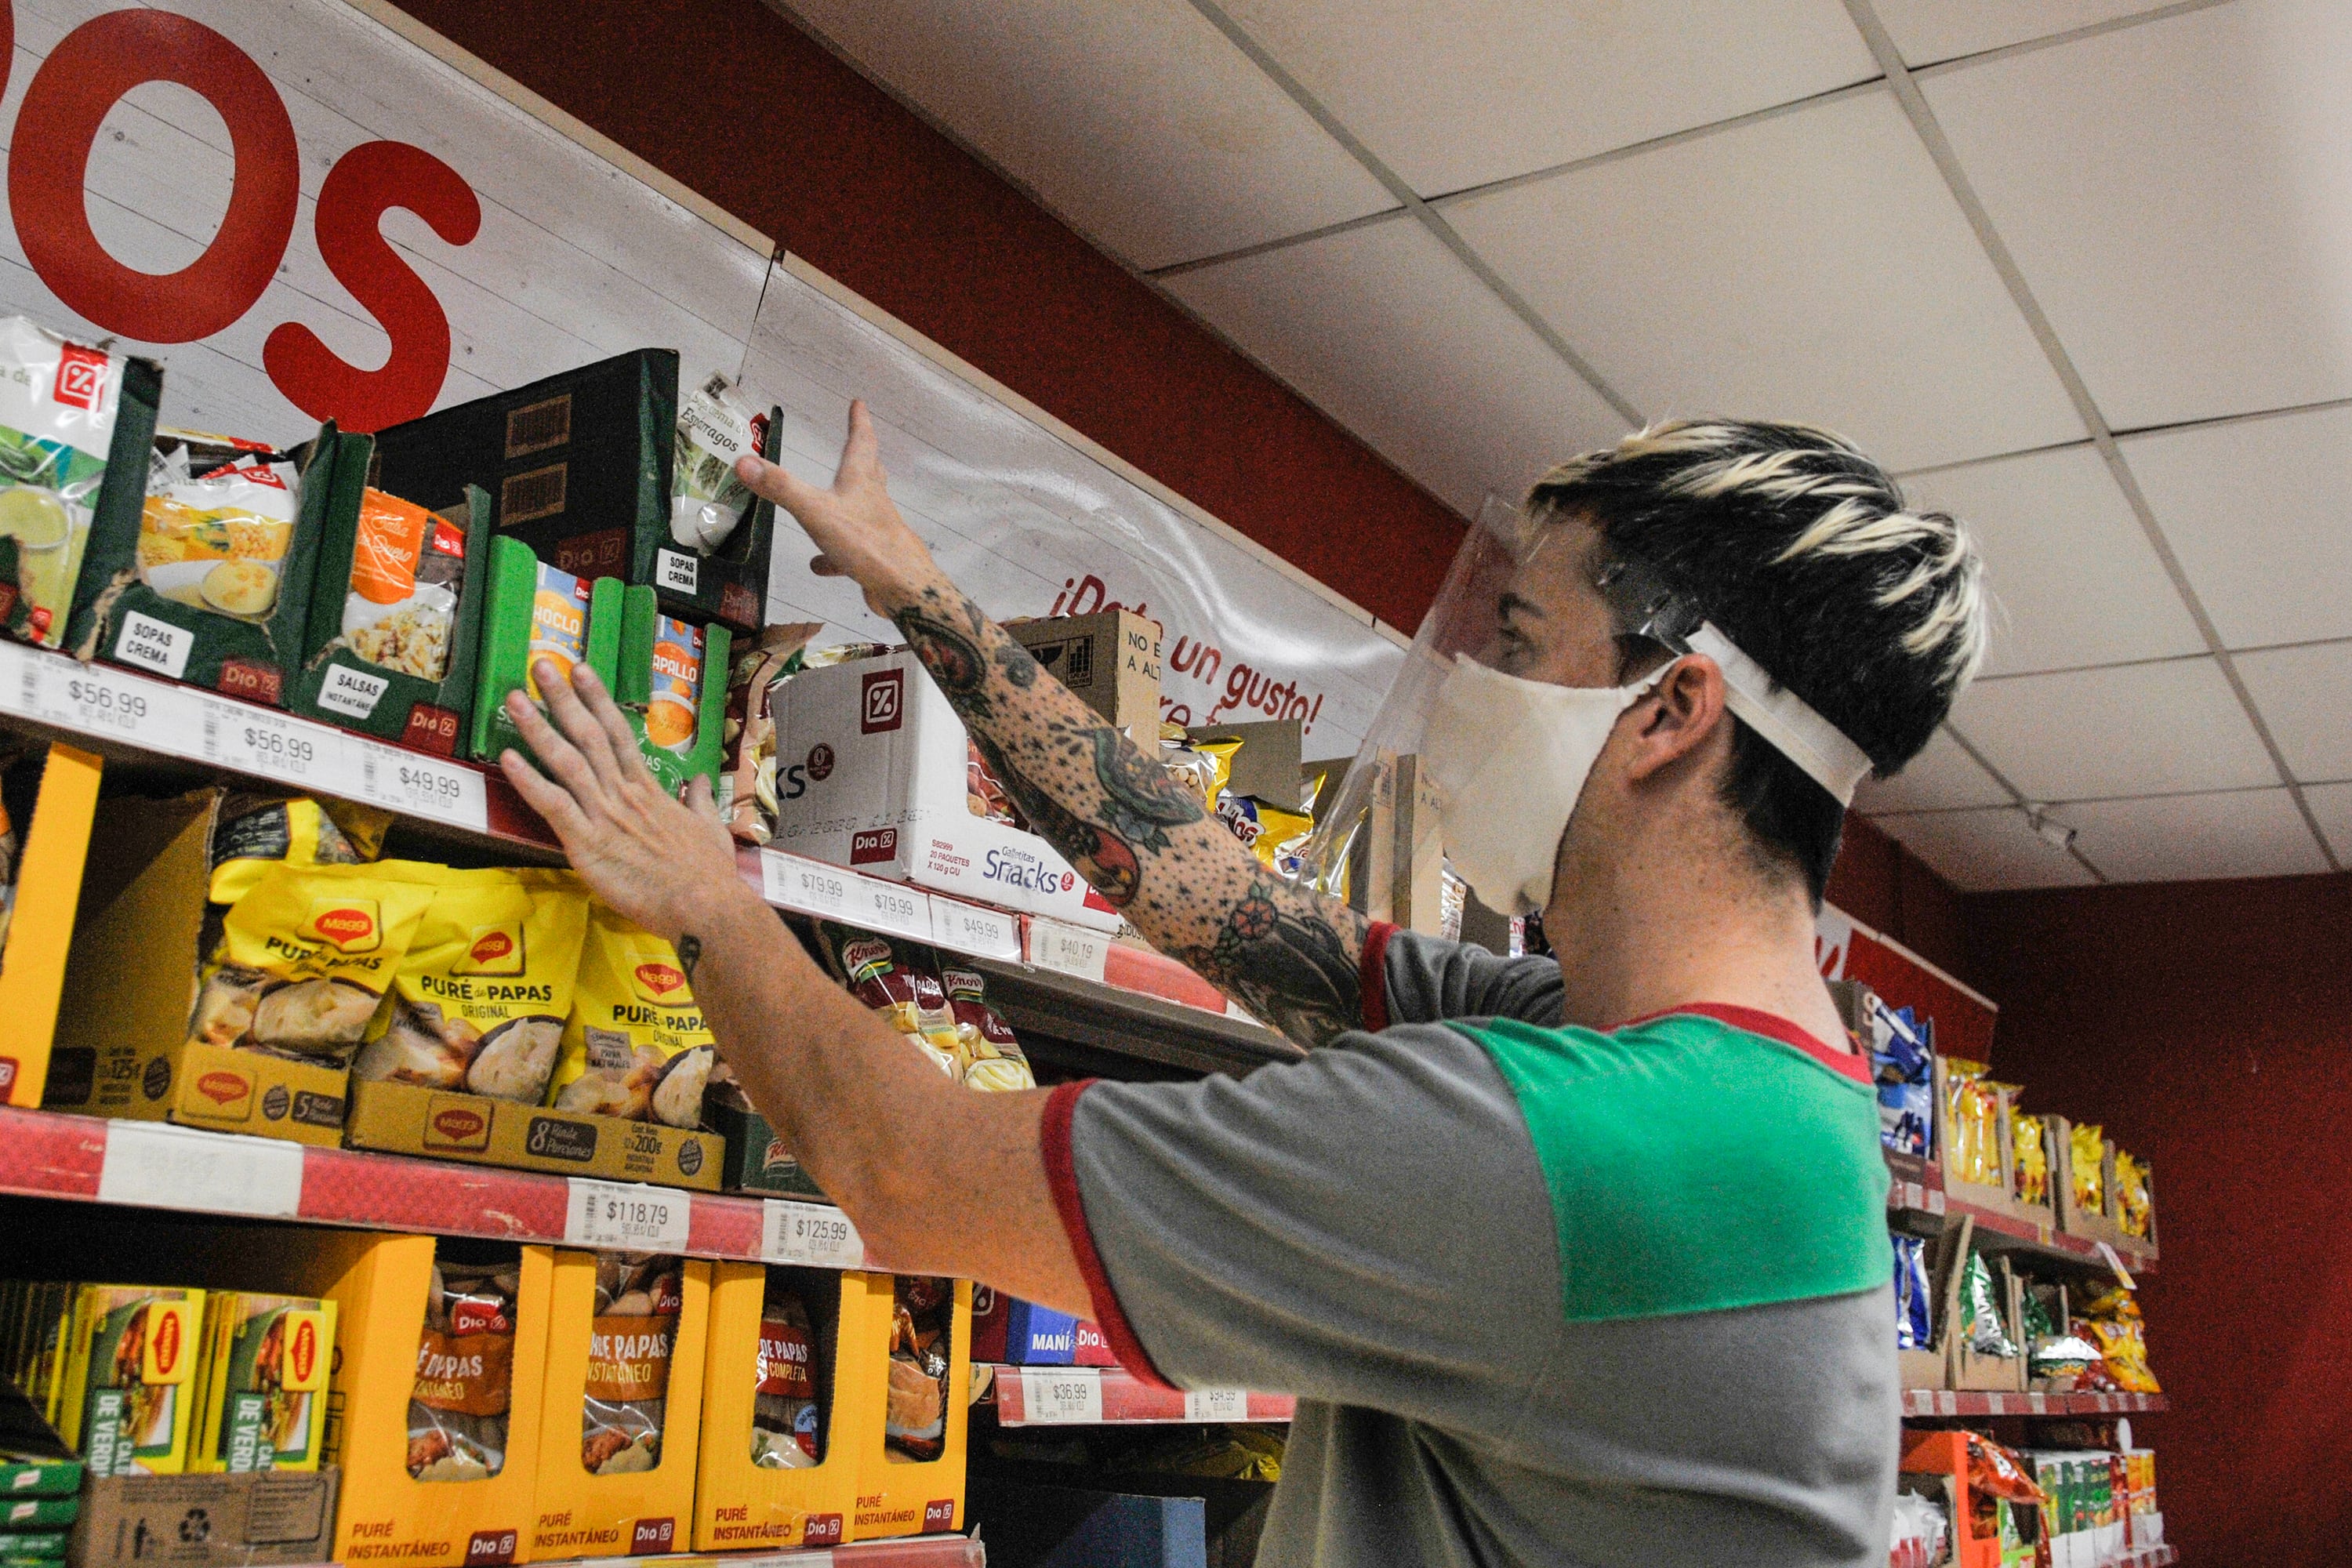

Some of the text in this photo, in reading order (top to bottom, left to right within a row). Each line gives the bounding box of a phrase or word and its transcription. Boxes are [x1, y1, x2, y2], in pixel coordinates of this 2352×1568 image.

[0, 0, 481, 434] OS
[670, 556, 695, 572] SOPAS
[668, 571, 695, 587] CREMA
[533, 606, 580, 636] HOCLO
[133, 623, 173, 647] SOPAS
[1128, 631, 1148, 652] NO
[126, 640, 169, 666] CREMA
[652, 654, 698, 683] APALLO
[1127, 655, 1137, 672] A
[337, 673, 379, 696] SALSAS
[1170, 635, 1222, 685] un
[1220, 663, 1323, 735] gusto!
[412, 711, 437, 730] Dia
[856, 836, 878, 850] Dia
[930, 851, 971, 867] 20 PAQUETES
[1002, 845, 1036, 863] Galletitas
[933, 862, 944, 873] 120
[983, 849, 1059, 894] Snacks
[323, 916, 369, 932] Maggi
[846, 942, 888, 968] Knorr
[640, 969, 678, 988] Maggi
[946, 972, 982, 988] Knorr
[421, 975, 474, 1000] PURÉ
[488, 985, 553, 1002] PAPAS
[462, 1004, 511, 1019] ORIGINAL
[531, 1121, 550, 1151] 8
[459, 1316, 486, 1330] Dia
[615, 1333, 669, 1361] PAPAS
[1079, 1329, 1099, 1347] Dia
[775, 1340, 808, 1363] PAPAS
[768, 1361, 808, 1383] COMPLETA
[97, 1395, 122, 1417] DE
[230, 1399, 263, 1472] DE VERD
[256, 1445, 274, 1472] CAL
[856, 1494, 881, 1509] PURÉ
[539, 1509, 572, 1528] PURÉ
[716, 1504, 748, 1522] PURÉ
[855, 1508, 916, 1526] INSTANTÁNEO
[926, 1506, 942, 1519] Dia
[352, 1519, 395, 1538] PURÉ
[535, 1527, 619, 1548] INSTANTÁNEO
[636, 1526, 657, 1541] Dia
[713, 1522, 792, 1541] INSTANTÁNEO
[807, 1522, 826, 1536] Dia
[347, 1537, 451, 1560] INSTANTÁNEO
[471, 1539, 496, 1555] Dia
